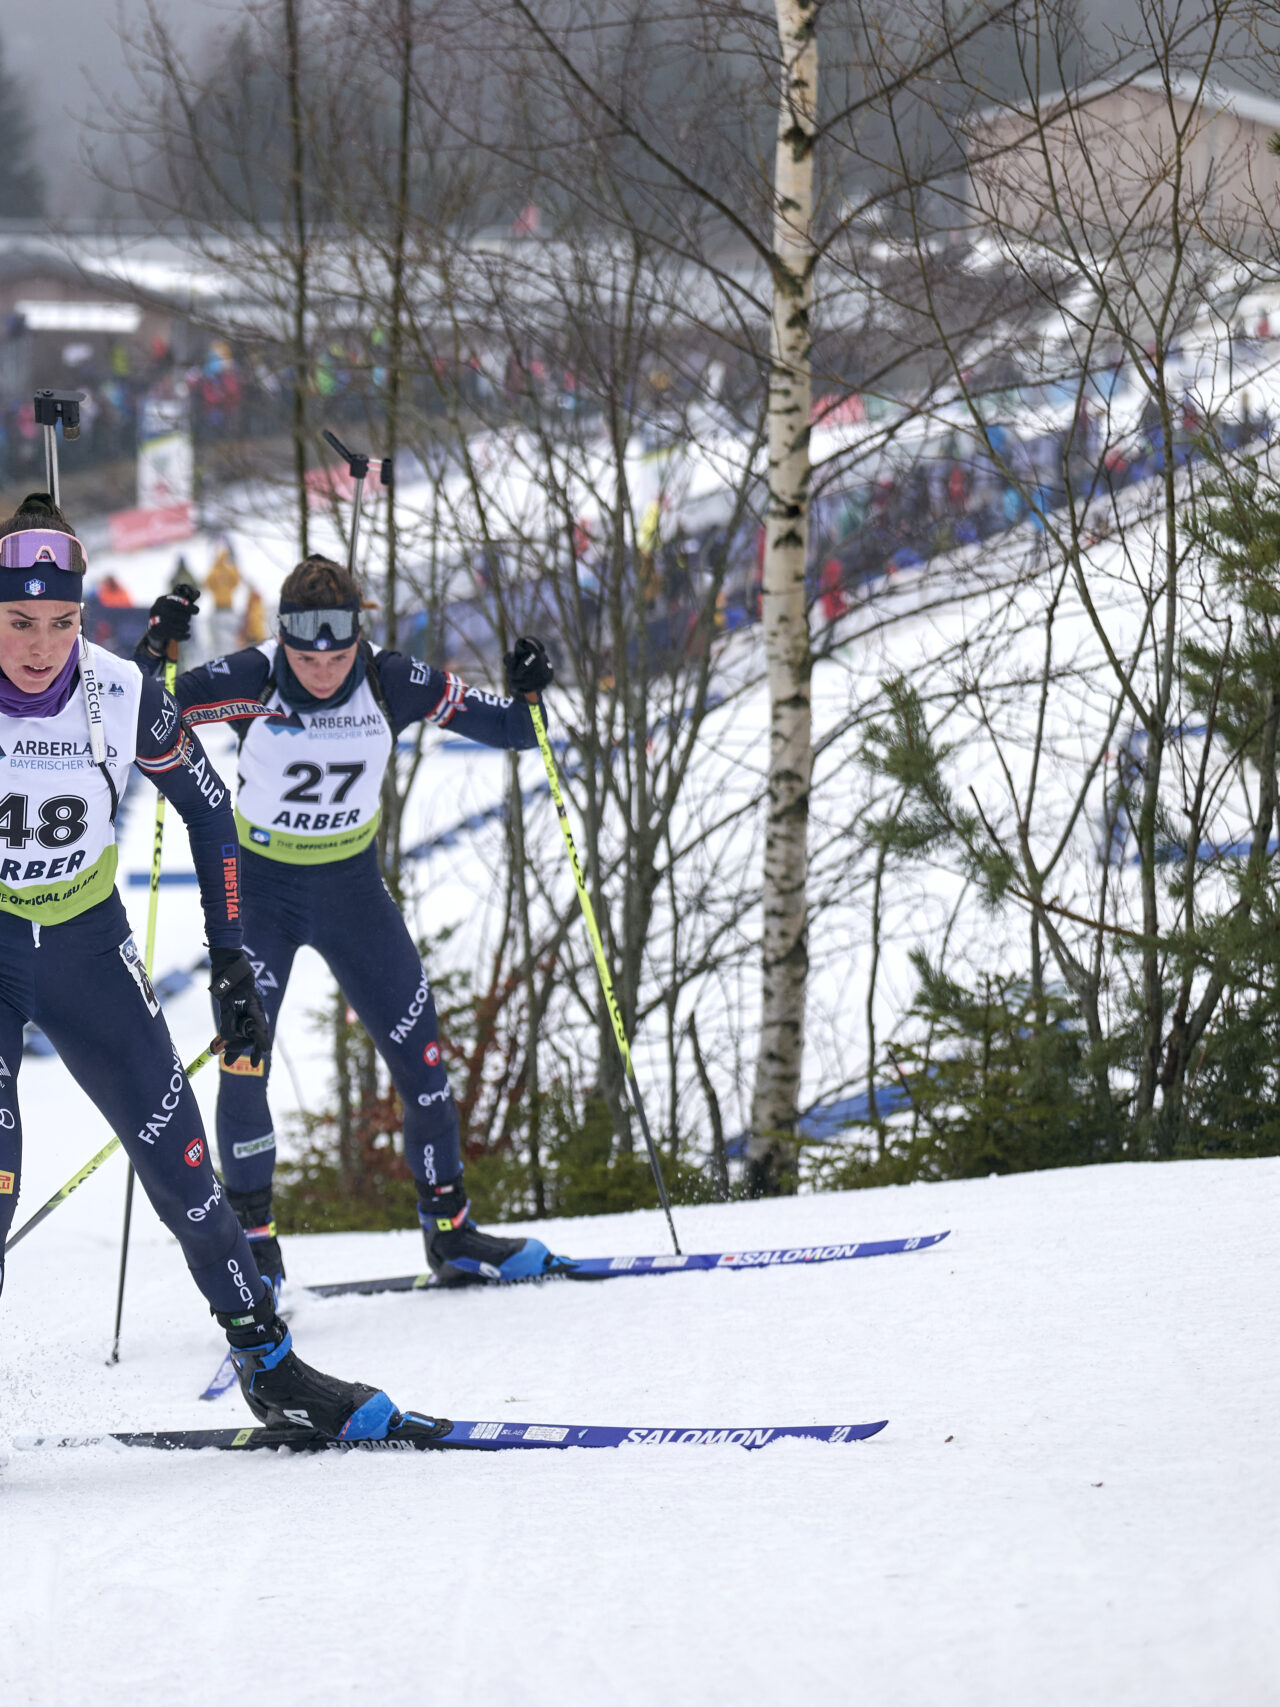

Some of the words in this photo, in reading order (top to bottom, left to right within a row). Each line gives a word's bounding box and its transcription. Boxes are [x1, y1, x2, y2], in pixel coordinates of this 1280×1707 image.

[83, 669, 102, 724] FIOCCHI
[464, 687, 514, 709] Aud
[12, 740, 118, 758] ARBERLAD
[10, 758, 84, 770] BAYERISCHER
[188, 756, 225, 809] Aud
[280, 760, 367, 805] 27
[272, 808, 361, 831] ARBER
[276, 839, 294, 849] THE
[295, 840, 339, 851] OFFICIAL
[9, 892, 61, 906] OFFICIAL
[738, 1244, 860, 1266] SALOMON
[625, 1428, 775, 1447] SALOMON
